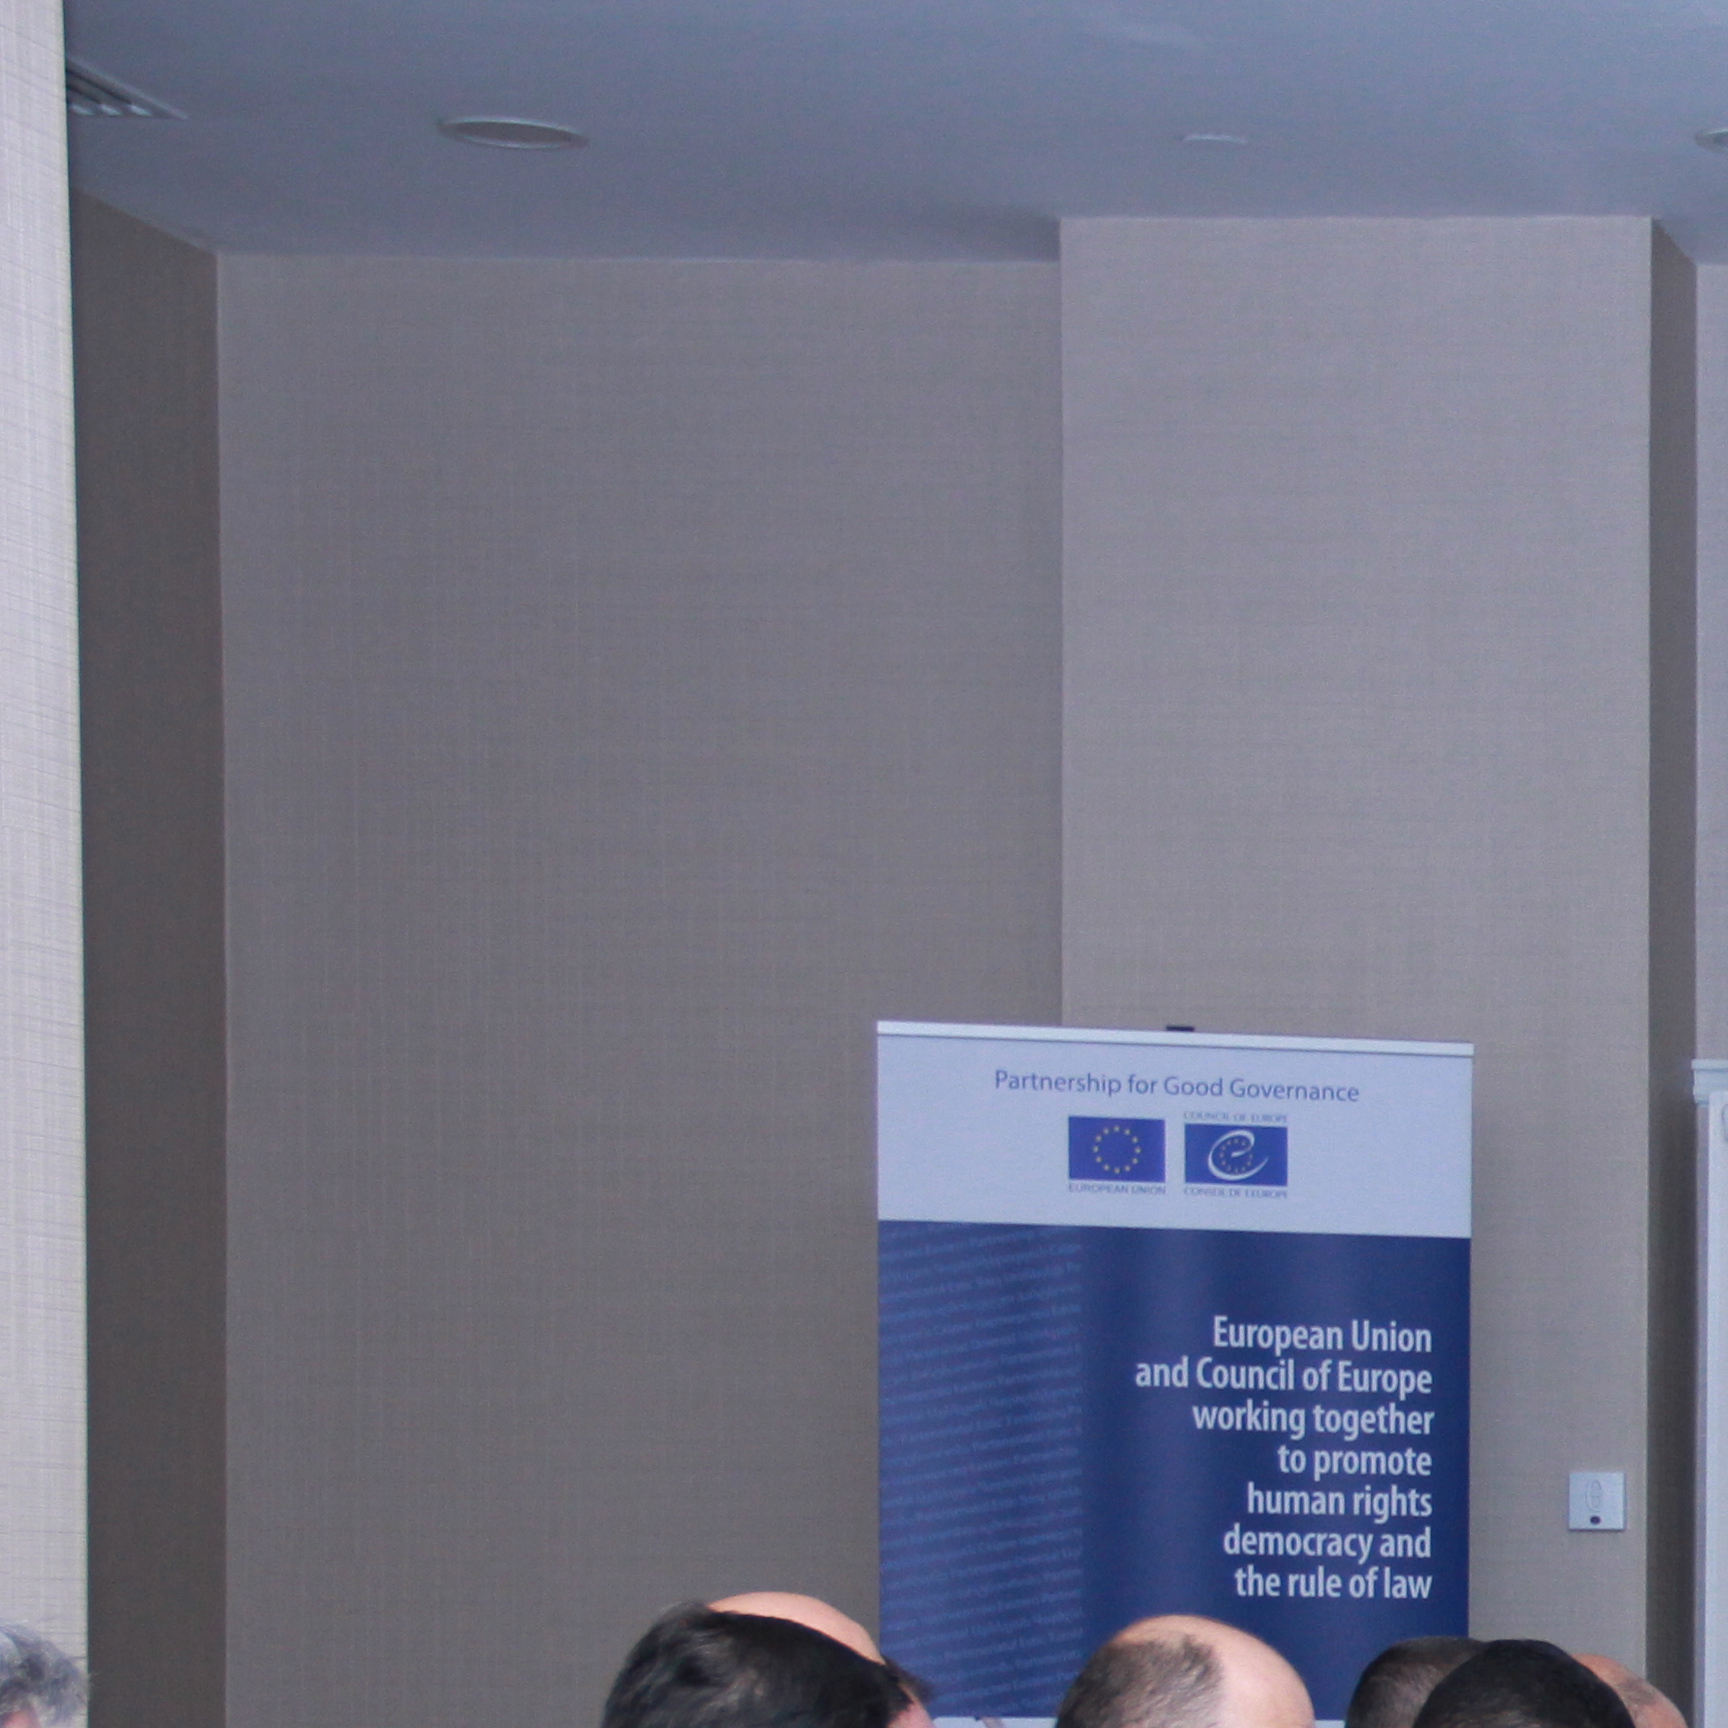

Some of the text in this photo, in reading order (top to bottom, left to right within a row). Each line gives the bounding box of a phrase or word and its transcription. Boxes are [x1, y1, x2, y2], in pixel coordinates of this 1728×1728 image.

[995, 1070, 1360, 1101] Partnership for Good Governance
[1213, 1315, 1432, 1356] European Union
[1135, 1356, 1433, 1402] and Council of Europe
[1193, 1400, 1435, 1443] working together
[1278, 1444, 1432, 1482] to promote
[1247, 1481, 1432, 1524] human rights
[1223, 1523, 1431, 1563] democracy and
[1235, 1566, 1432, 1600] the rule of law
